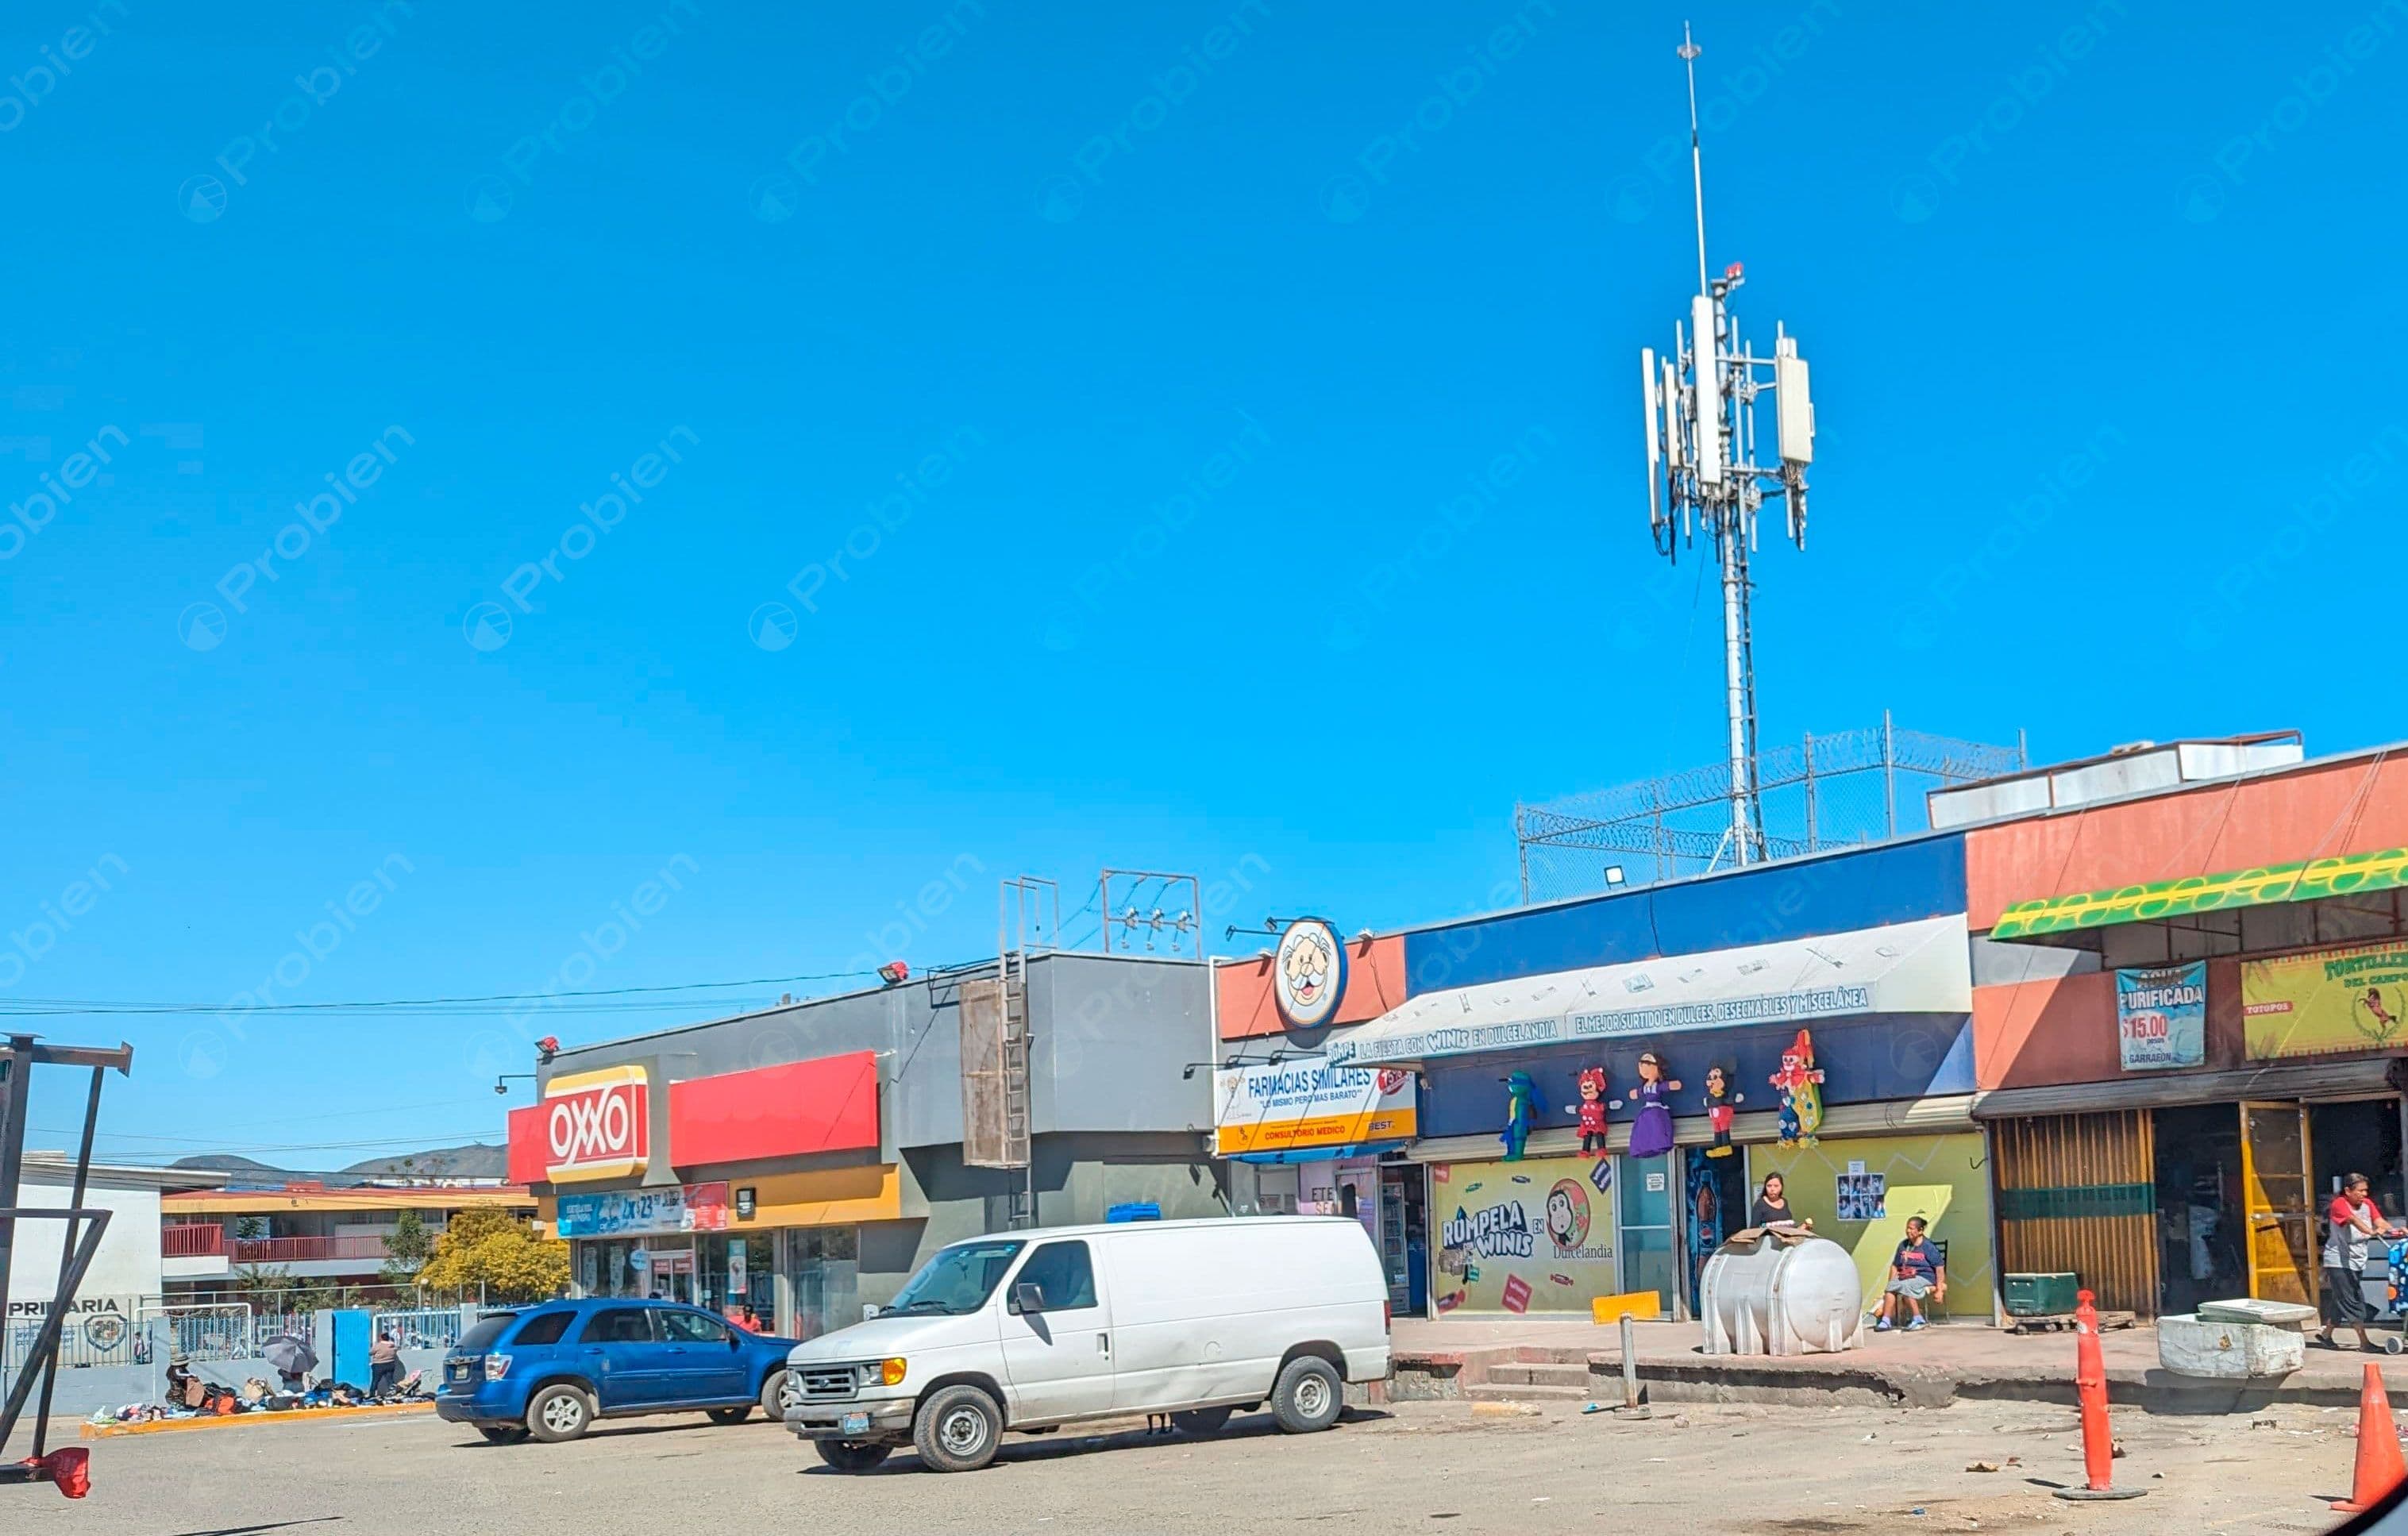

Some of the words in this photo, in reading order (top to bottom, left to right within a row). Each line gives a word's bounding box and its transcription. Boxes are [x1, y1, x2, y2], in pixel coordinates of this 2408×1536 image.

[2119, 985, 2203, 1010] PURIFICADA
[1575, 1016, 1586, 1034] EL
[1588, 1013, 1620, 1034] MEJOR
[1620, 1009, 1661, 1030] SURTIDO
[1662, 1008, 1676, 1028] EN
[1717, 995, 1788, 1021] DESECHABLES
[1788, 994, 1799, 1014] Y
[1797, 985, 1868, 1014] MISCELÁNEA
[2247, 1003, 2289, 1014] TOTOPOS
[1327, 1041, 1355, 1064] ROMPE
[1359, 1045, 1372, 1060] LA
[1373, 1040, 1404, 1057] FIESTA
[1405, 1037, 1424, 1055] CON
[1426, 1028, 1469, 1051] WINIS
[1472, 1030, 1486, 1047] EN
[1488, 1019, 1558, 1045] DULCELANDIA
[1249, 1069, 1308, 1099] FARMACIAS
[1312, 1068, 1370, 1091] SIMILARES
[1272, 1098, 1294, 1107] MISMO
[1295, 1095, 1312, 1105] PERO
[1313, 1093, 1328, 1102] MAS
[549, 1085, 629, 1167] OXXO
[1265, 1128, 1314, 1141] CONSULTORIO
[1316, 1125, 1346, 1136] MEDICO
[1368, 1120, 1393, 1132] BEST
[1532, 1218, 1545, 1234] EN
[1474, 1231, 1533, 1259] WINIS
[1553, 1244, 1613, 1260] Dulcelandia
[9, 1298, 118, 1316] PRIARIA
